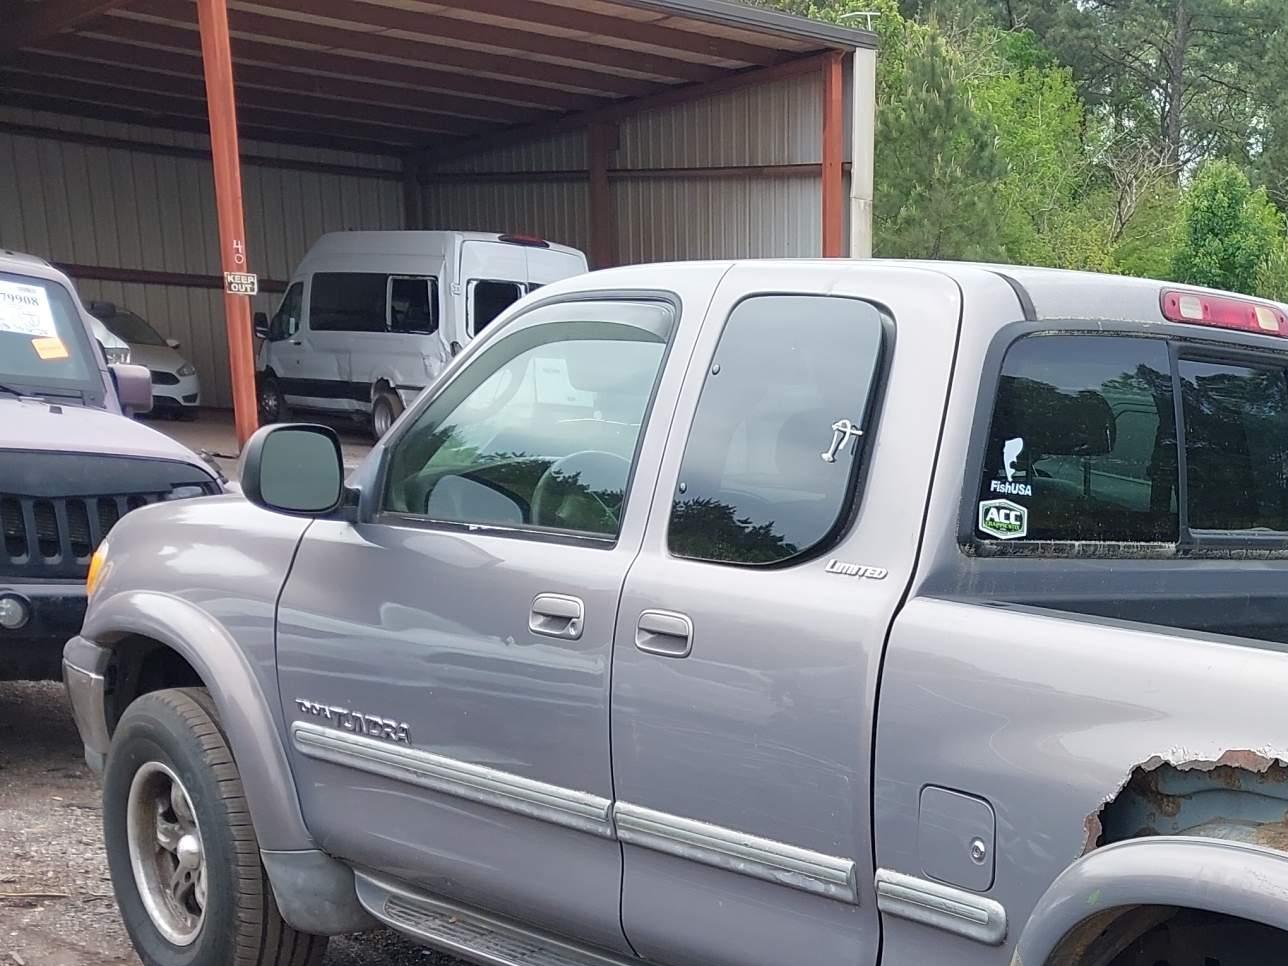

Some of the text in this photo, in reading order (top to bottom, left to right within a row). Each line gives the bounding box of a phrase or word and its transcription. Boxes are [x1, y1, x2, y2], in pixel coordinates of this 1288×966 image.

[227, 274, 254, 284] KEEP
[230, 283, 252, 292] OUT
[990, 480, 1032, 496] FishUSA
[985, 507, 1021, 525] ACC
